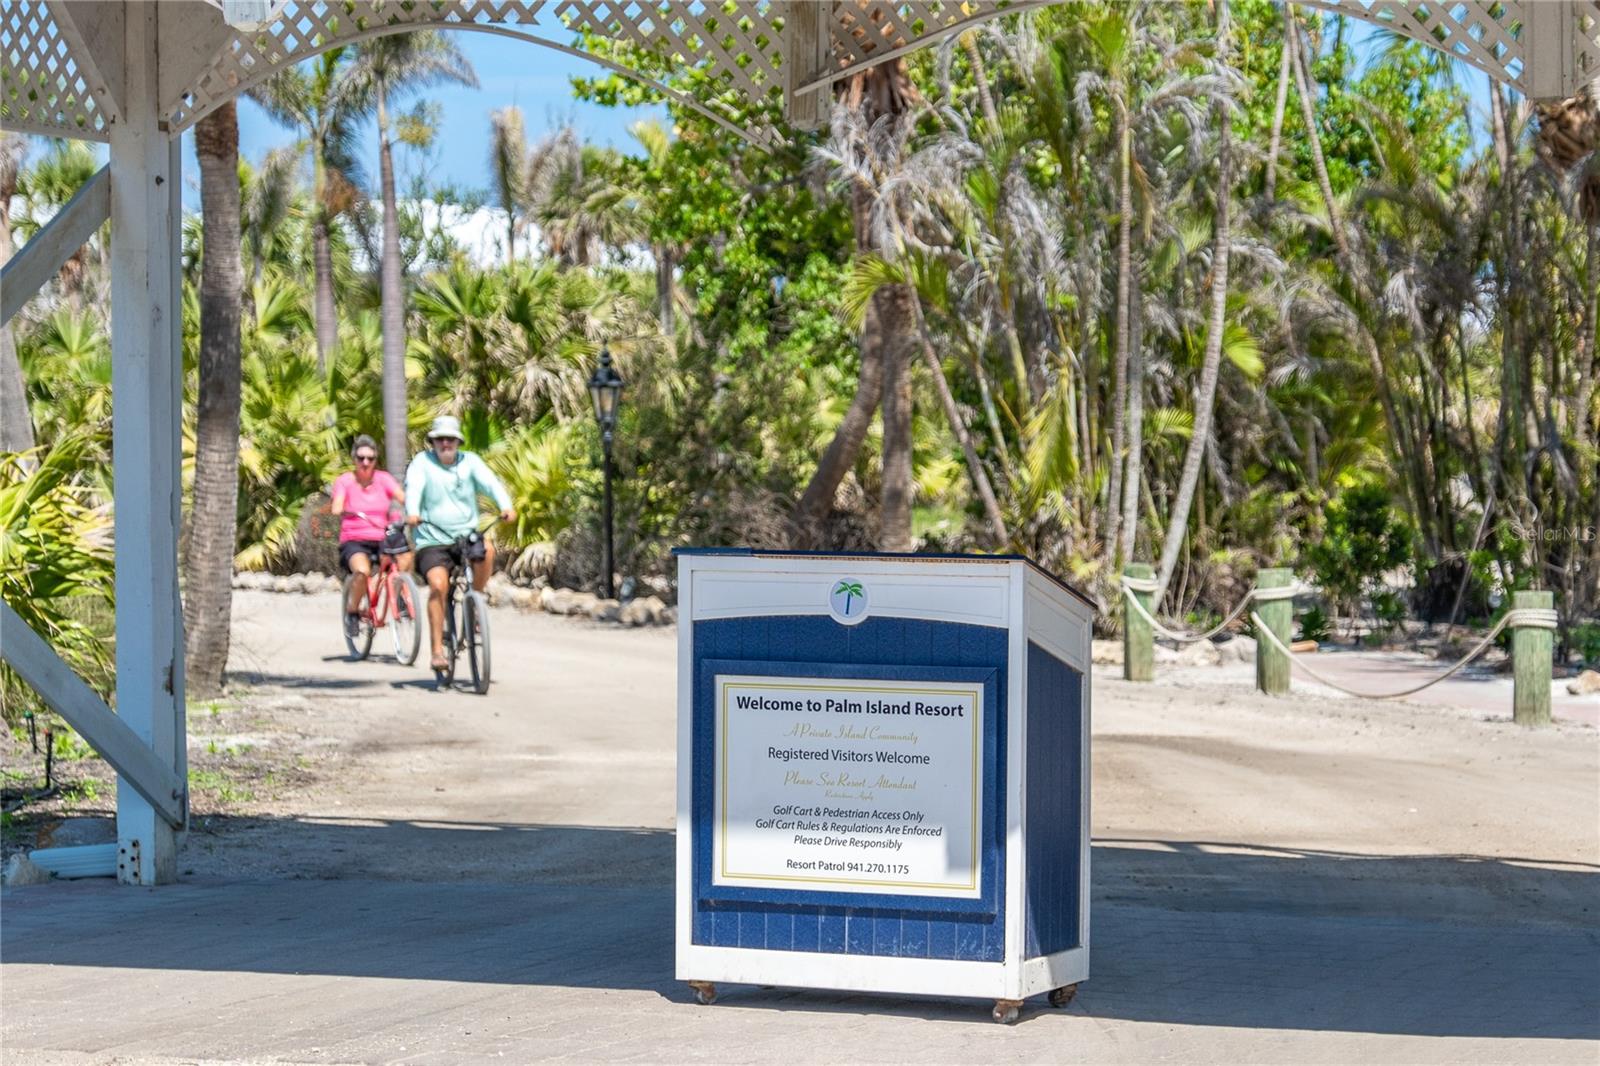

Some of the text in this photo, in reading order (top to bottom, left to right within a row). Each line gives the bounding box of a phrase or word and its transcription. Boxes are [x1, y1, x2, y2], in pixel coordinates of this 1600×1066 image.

[737, 696, 964, 716] Welcome to Palm Island Resort
[798, 724, 832, 738] Private
[835, 726, 867, 740] Island
[869, 726, 918, 744] Community
[768, 747, 930, 764] Registered Visitors Welcome
[784, 771, 916, 790] Please See Resort Attendant
[773, 805, 924, 822] Golf Cart & Pedestrian Access Only
[755, 819, 942, 837] Golf Cart Rules & Regulations Are Enforced
[794, 835, 902, 850] Please Drive Responsibly
[787, 859, 909, 874] Resort Patrol 941.270.1175
